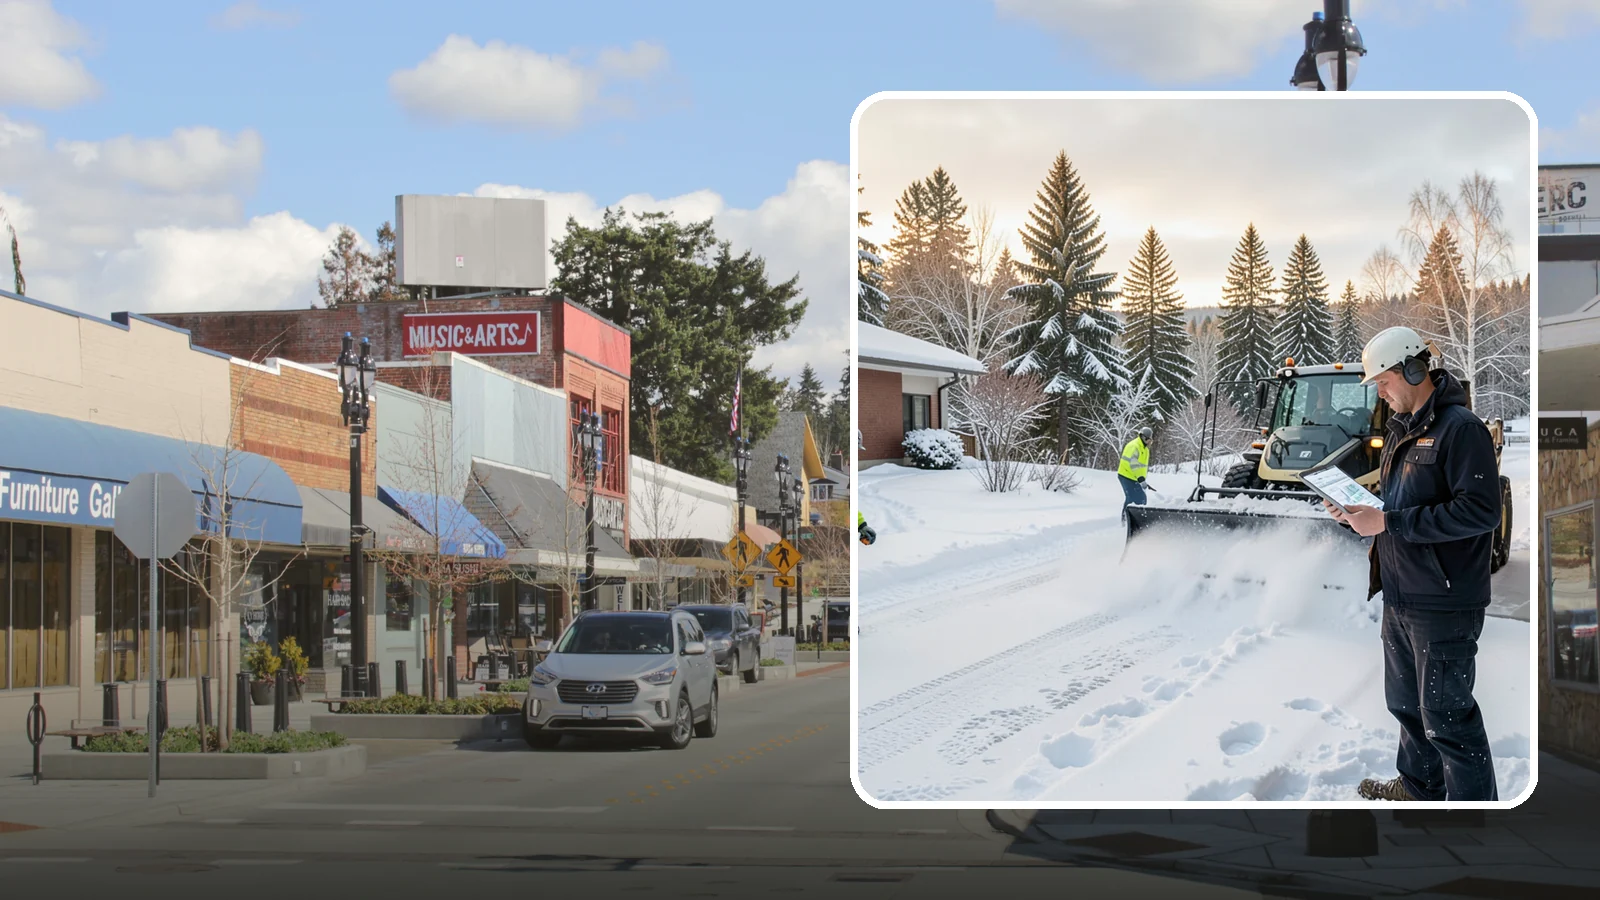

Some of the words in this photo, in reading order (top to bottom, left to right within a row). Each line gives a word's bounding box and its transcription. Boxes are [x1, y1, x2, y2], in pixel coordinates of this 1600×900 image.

[0, 471, 79, 515] Furniture
[89, 482, 121, 519] Gal
[453, 562, 479, 575] SUSHI
